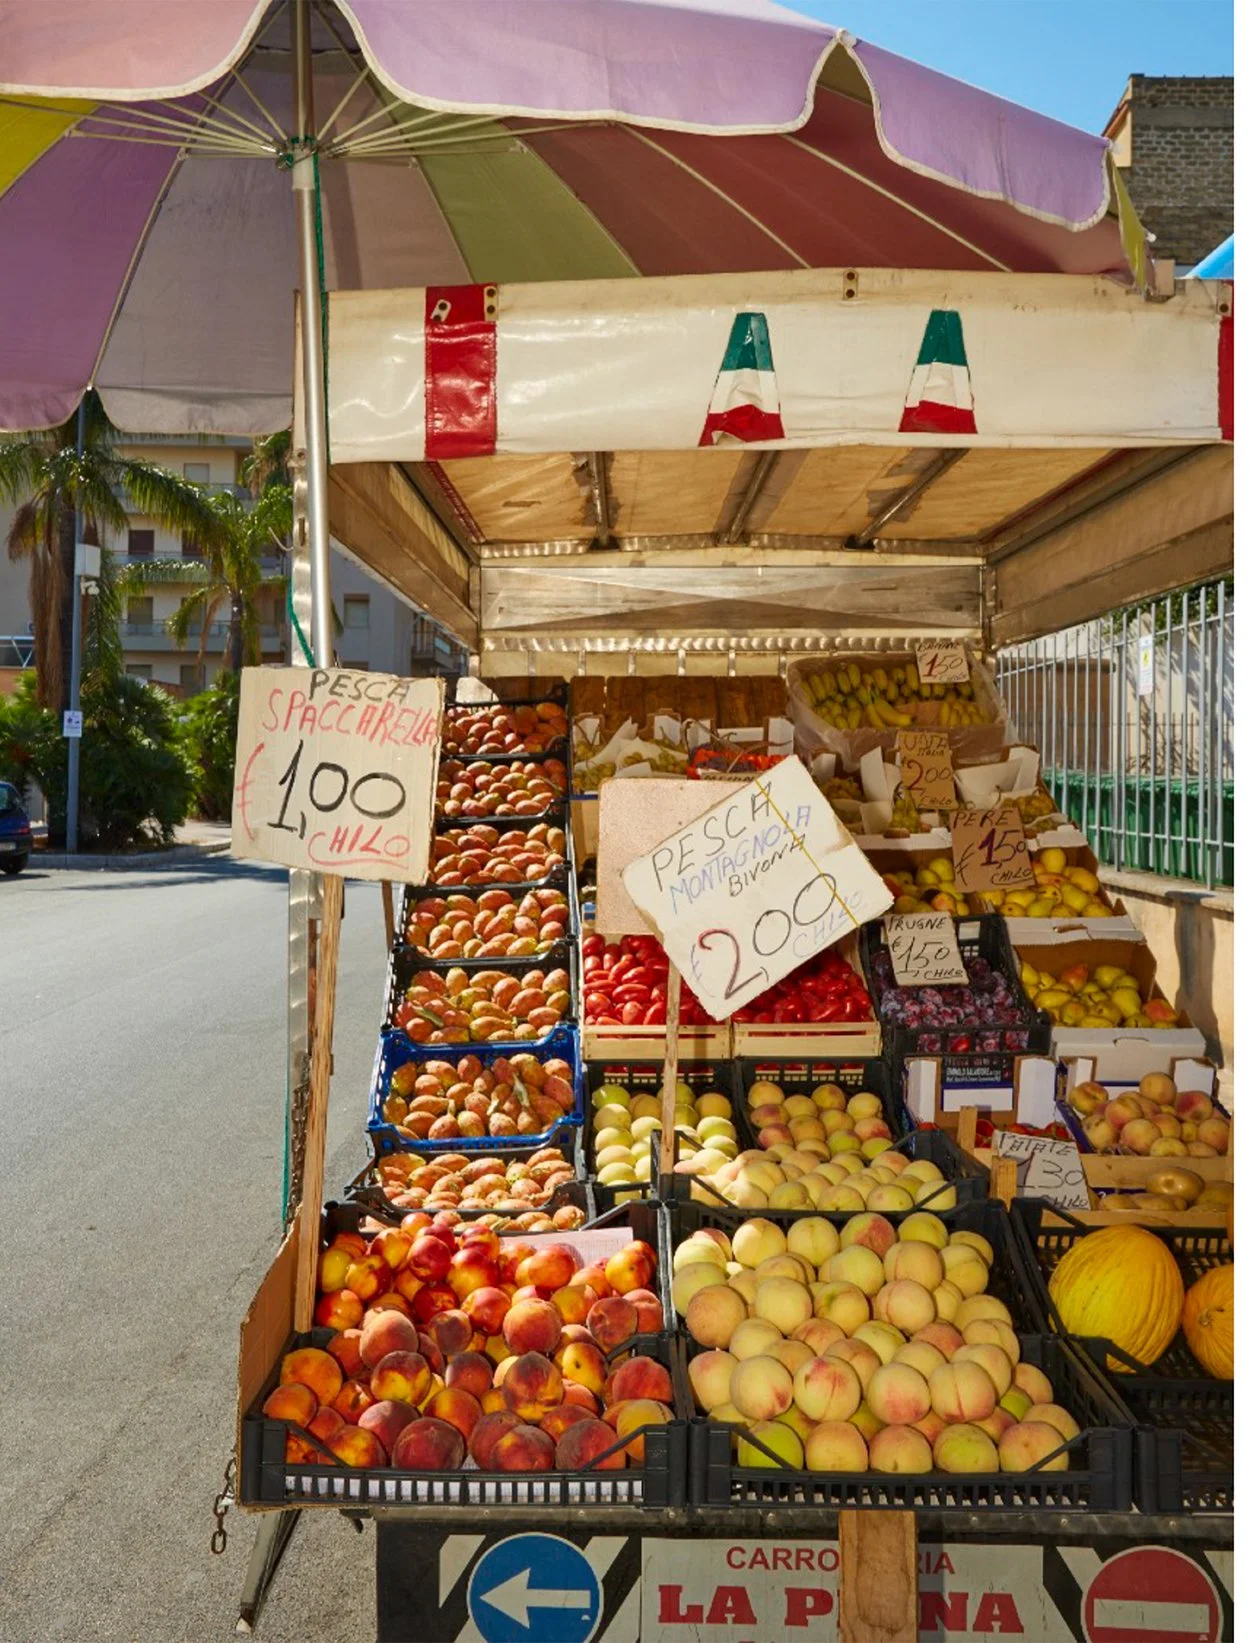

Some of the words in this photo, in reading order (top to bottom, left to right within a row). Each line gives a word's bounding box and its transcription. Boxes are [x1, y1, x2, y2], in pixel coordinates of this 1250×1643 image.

[310, 670, 411, 703] PESCA
[262, 688, 437, 747] SPACCARELLA
[651, 781, 772, 892] PESCA
[953, 810, 1015, 829] PERE
[307, 824, 411, 870] CHILO
[669, 805, 811, 914] MONTAGNOLA
[729, 834, 806, 897] BIVONA
[991, 867, 1033, 886] CHILO
[791, 889, 864, 959] CHILO
[888, 915, 947, 932] PRUGNE
[923, 967, 964, 980] CHILO
[998, 1132, 1077, 1155] PATATE
[658, 1584, 757, 1625] LA
[784, 1586, 1024, 1634] PNA
